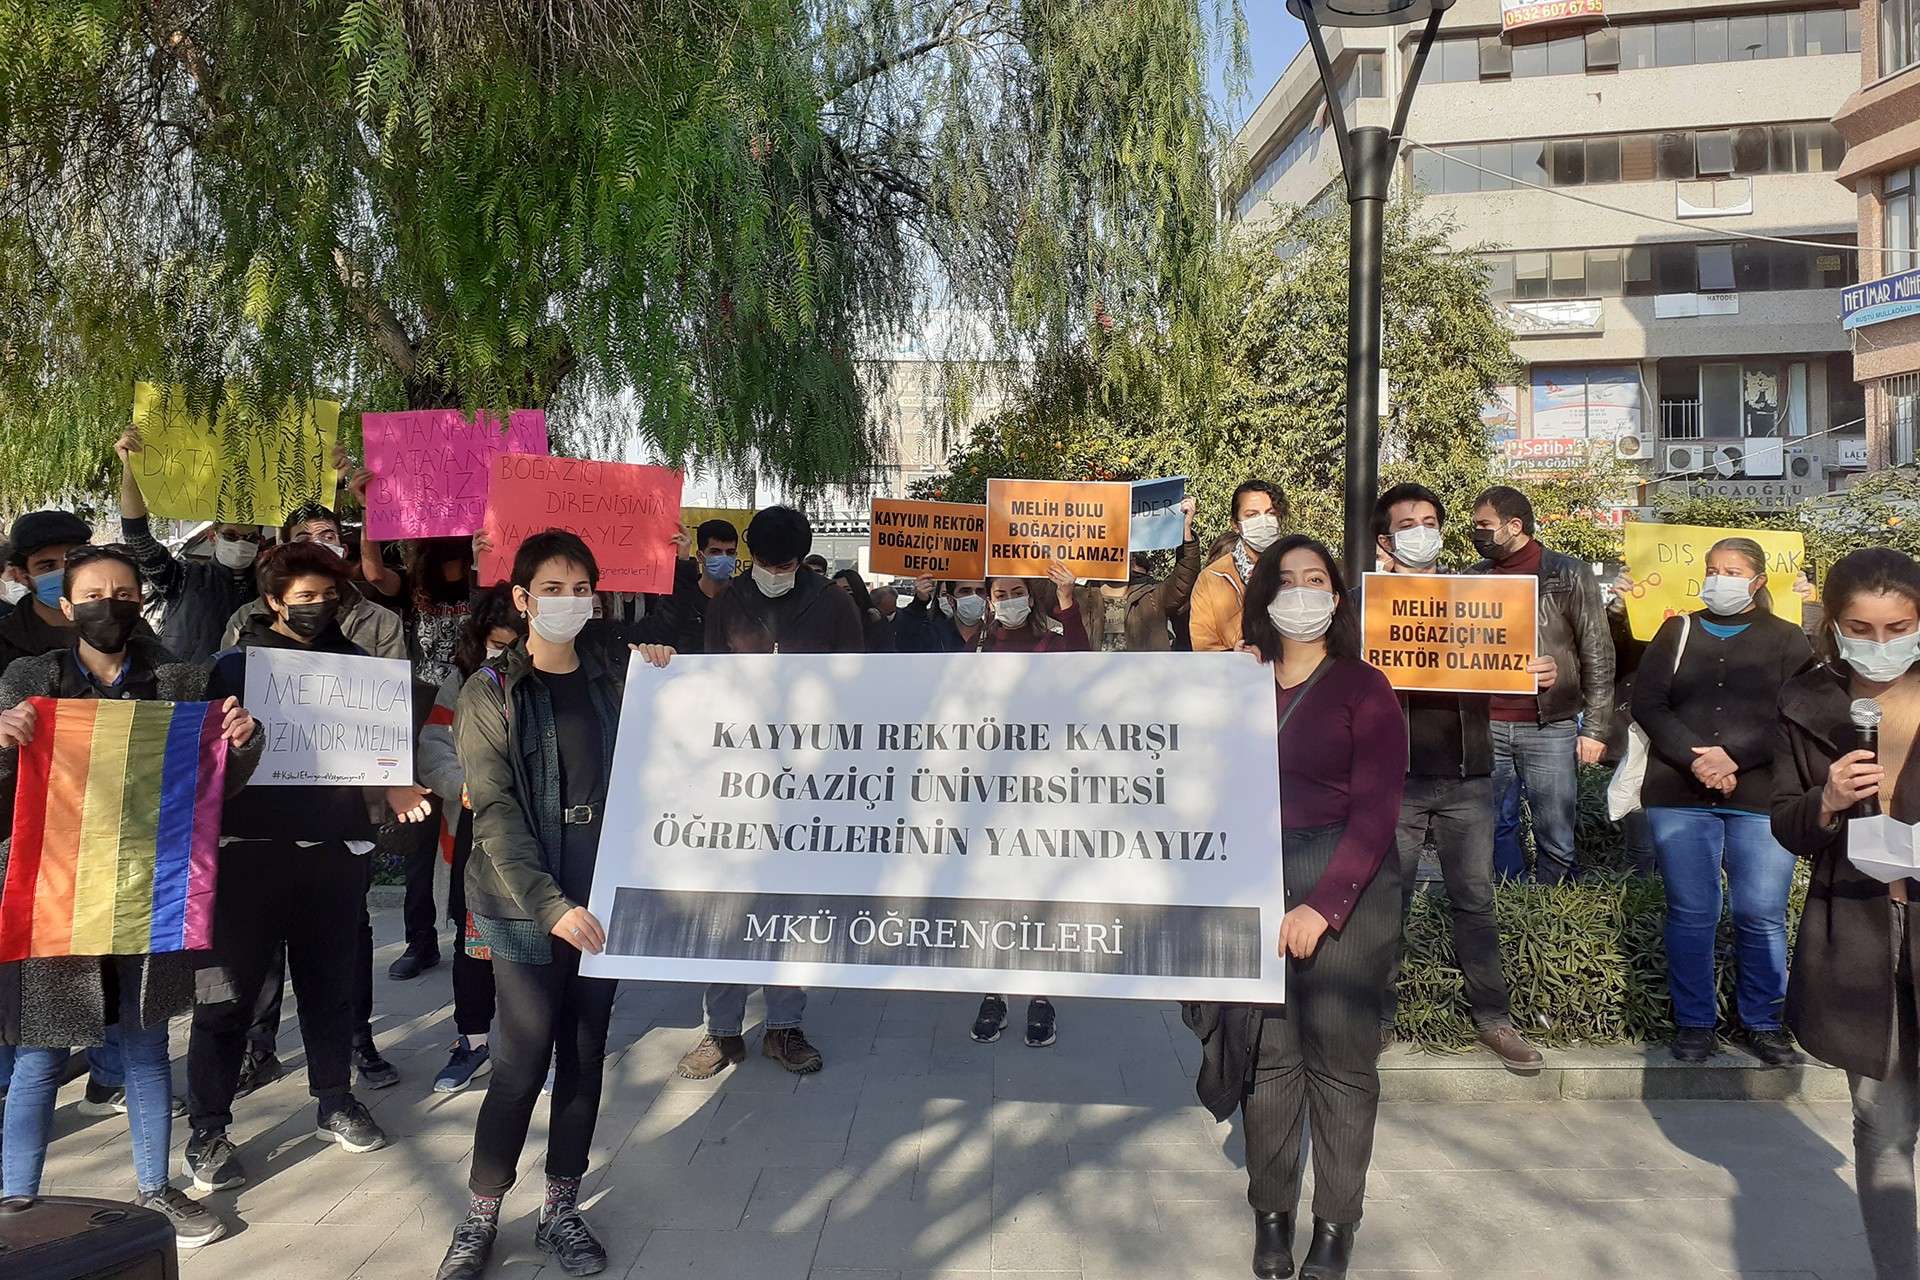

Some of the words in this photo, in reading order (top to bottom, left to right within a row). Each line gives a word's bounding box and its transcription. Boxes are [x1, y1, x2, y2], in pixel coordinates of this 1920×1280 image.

[1506, 7, 1540, 26] 0532
[1542, 3, 1568, 17] 607
[1569, 1, 1585, 14] 67
[1587, 0, 1603, 12] 55
[1843, 289, 1865, 312] NET
[1508, 457, 1535, 469] Lens
[1689, 481, 1803, 496] HOCAOĞLU
[545, 490, 666, 517] DİRENİŞİNİN
[1010, 498, 1060, 518] MELİH
[1064, 501, 1104, 519] BULU
[874, 510, 930, 529] KAYYUM
[933, 513, 985, 533] REKTÖR
[1008, 519, 1107, 543] BOĞAZİÇİ'NE
[877, 531, 979, 555] BOĞAZİÇİ'NDEN
[991, 541, 1051, 560] REKTÖR
[1056, 544, 1125, 563] OLAMAZ!
[1657, 542, 1695, 567] DIŞ
[903, 554, 951, 572] DEFOL!
[1392, 597, 1448, 618] MELİH
[1455, 601, 1503, 620] BULU
[1389, 621, 1507, 649] BOĞAZİÇİ'NE
[1368, 646, 1440, 669] REKTÖR
[264, 673, 408, 713] METALLICA
[266, 716, 347, 753] İZİMDİR
[353, 721, 409, 752] MELİH
[711, 721, 864, 751] KAYYUM
[876, 717, 1051, 751] REKTÖRE
[1065, 723, 1180, 760] KARŞI
[718, 765, 895, 810] BOĞAZİÇİ
[910, 766, 1168, 805] ÜNİVERSİTESİ
[652, 812, 970, 855] ÖĞRENCİLERİNİN
[984, 828, 1228, 862] YANINDAYIZ!
[743, 908, 837, 945] MKÜ
[849, 910, 1124, 955] ÖĞRENCİLERİ
